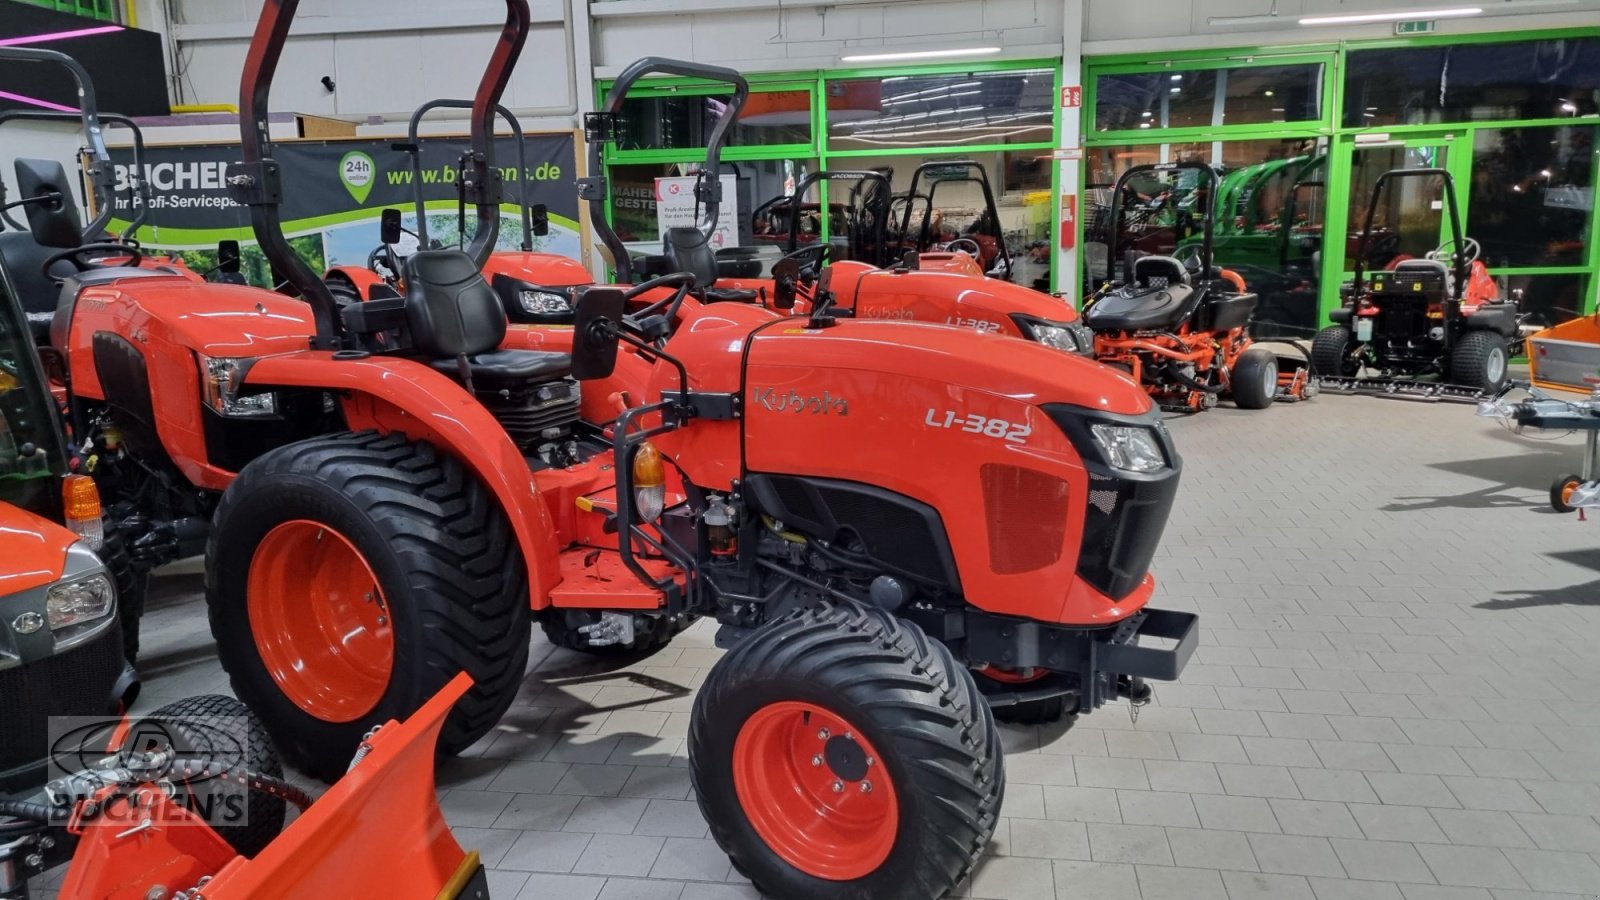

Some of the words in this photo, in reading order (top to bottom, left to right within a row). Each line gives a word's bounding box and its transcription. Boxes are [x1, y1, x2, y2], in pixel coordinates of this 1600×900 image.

[346, 161, 369, 173] 24h
[863, 305, 914, 320] Kubota
[753, 386, 849, 416] Kubota
[925, 408, 1032, 444] L1-382
